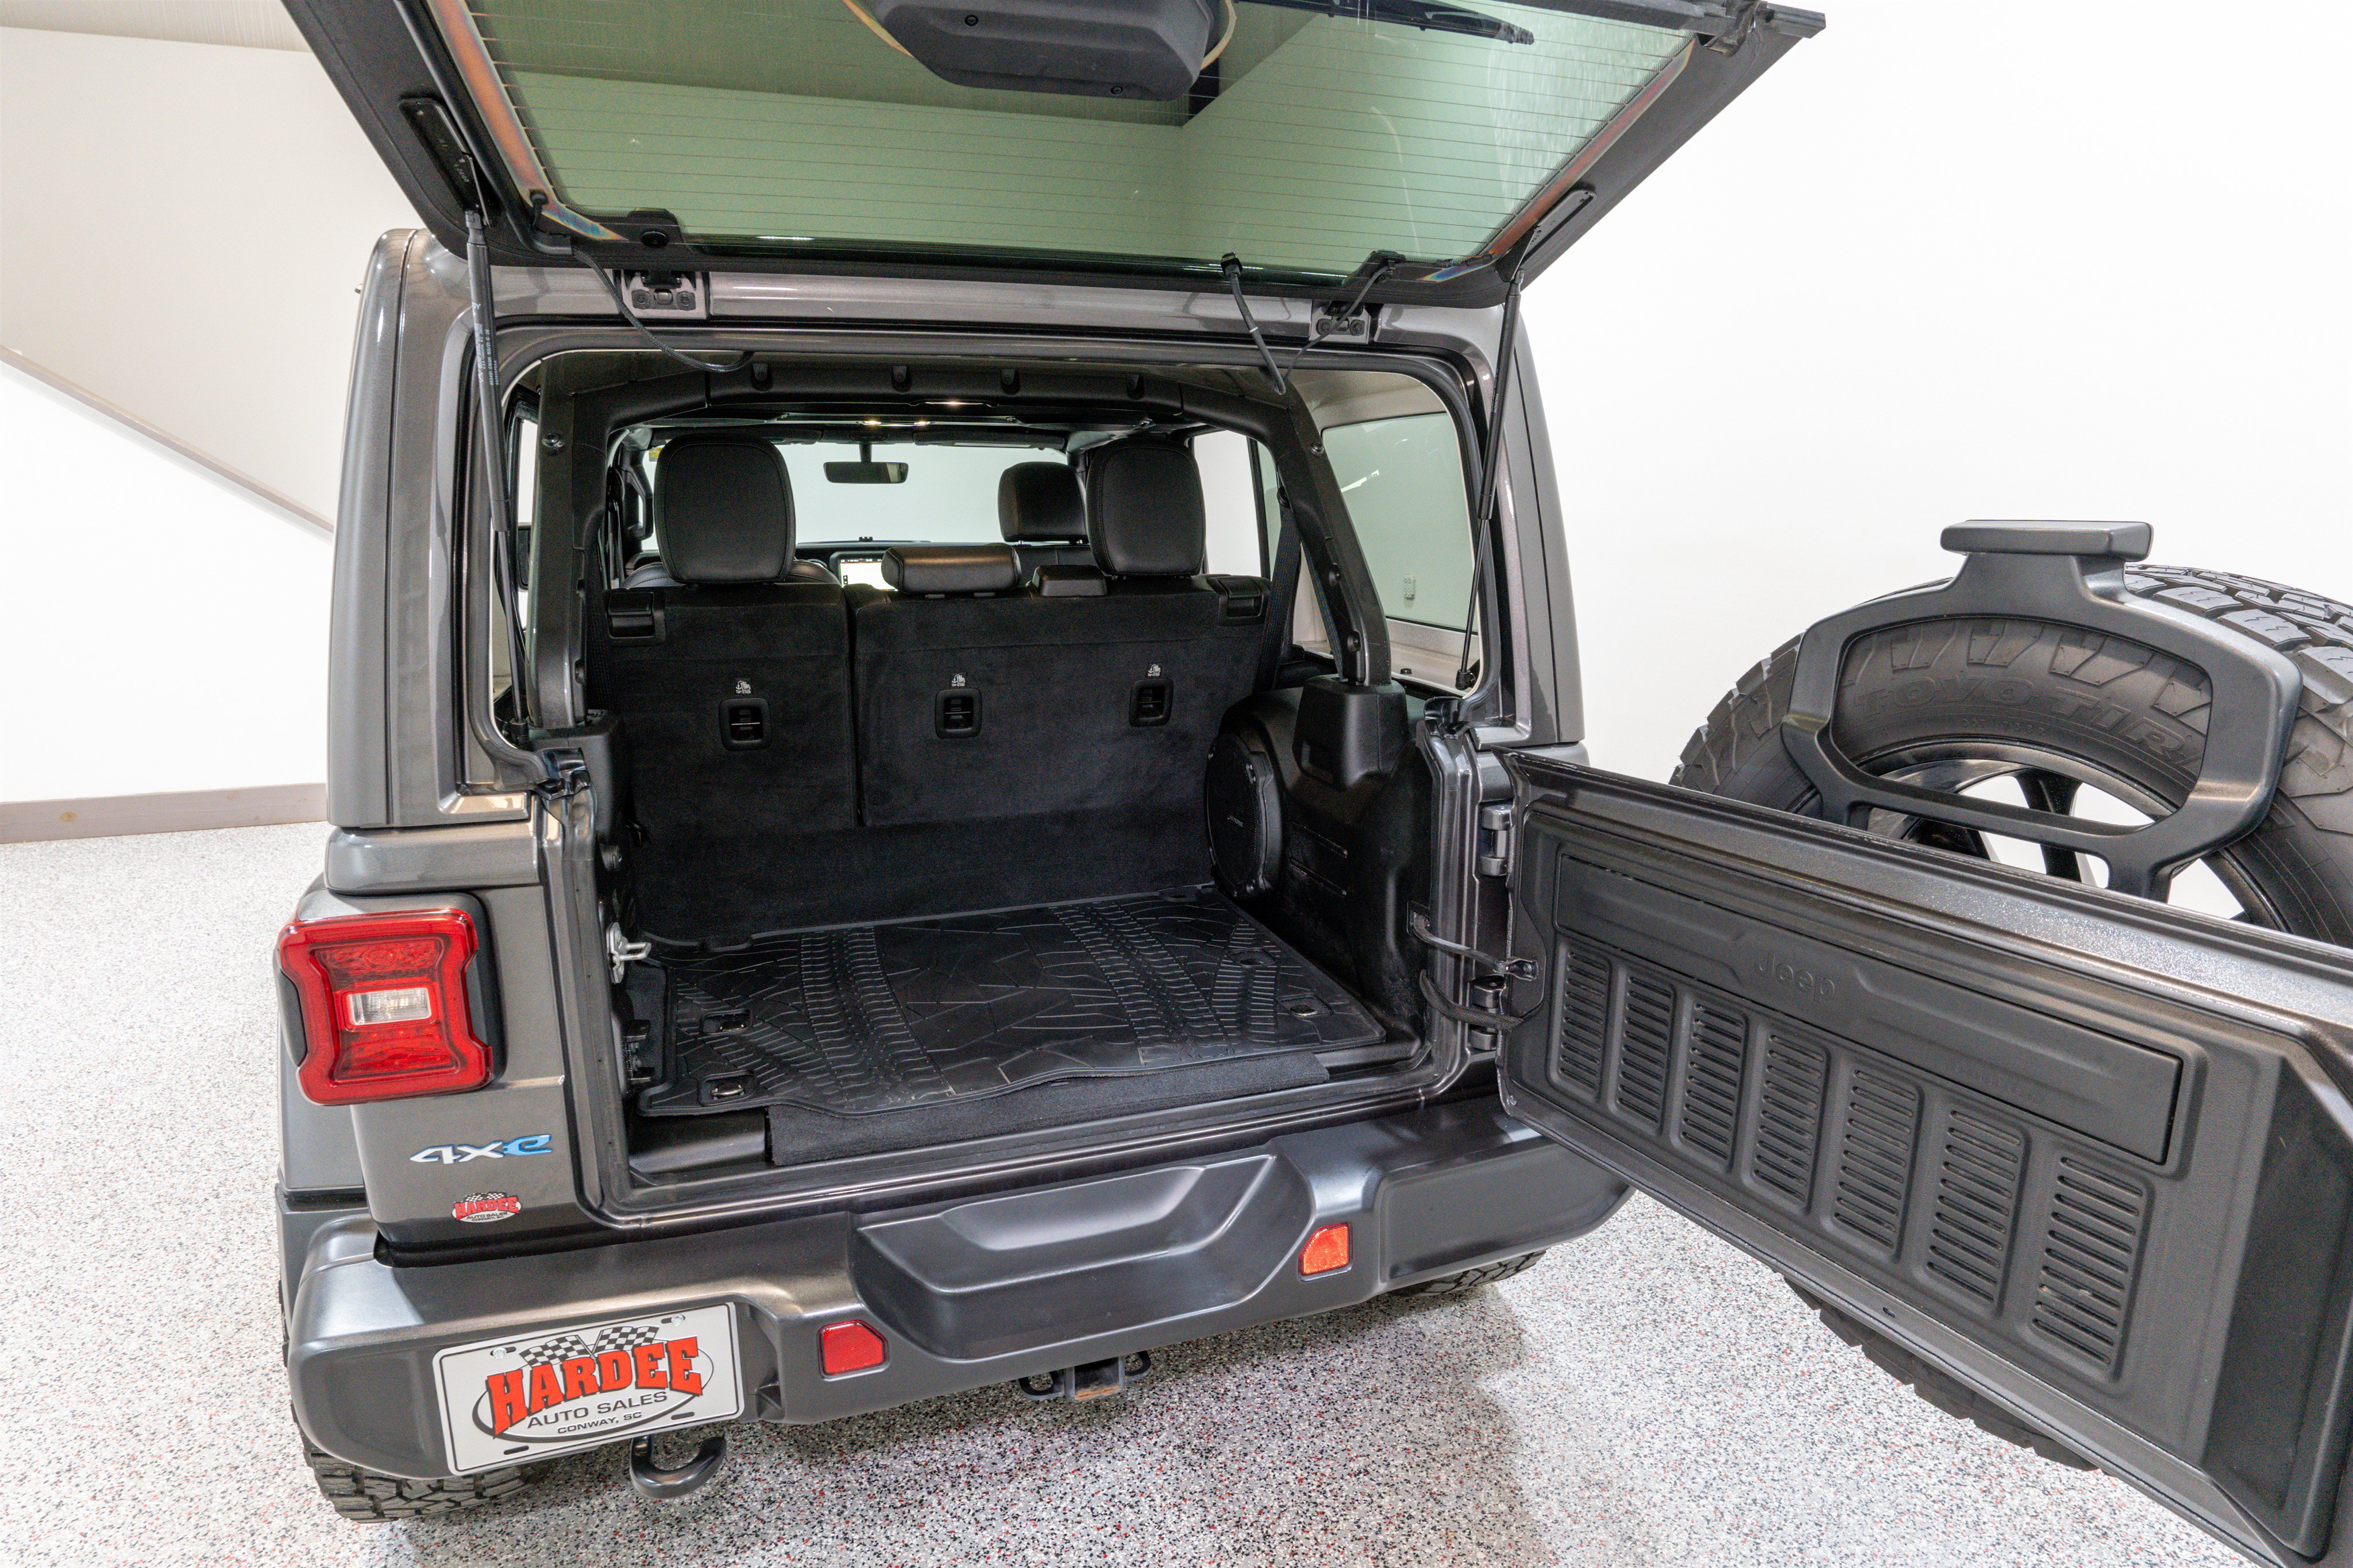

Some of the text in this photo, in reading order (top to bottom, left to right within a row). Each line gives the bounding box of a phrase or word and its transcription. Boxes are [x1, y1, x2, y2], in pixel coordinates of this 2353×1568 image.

[1855, 677, 2036, 719] TOYO
[1754, 951, 1836, 1004] Jeep
[454, 1195, 519, 1221] HARDEE
[485, 1336, 703, 1436] HARDEE
[527, 1391, 668, 1429] AUTO SALES
[557, 1411, 643, 1434] CONWAY, SC
